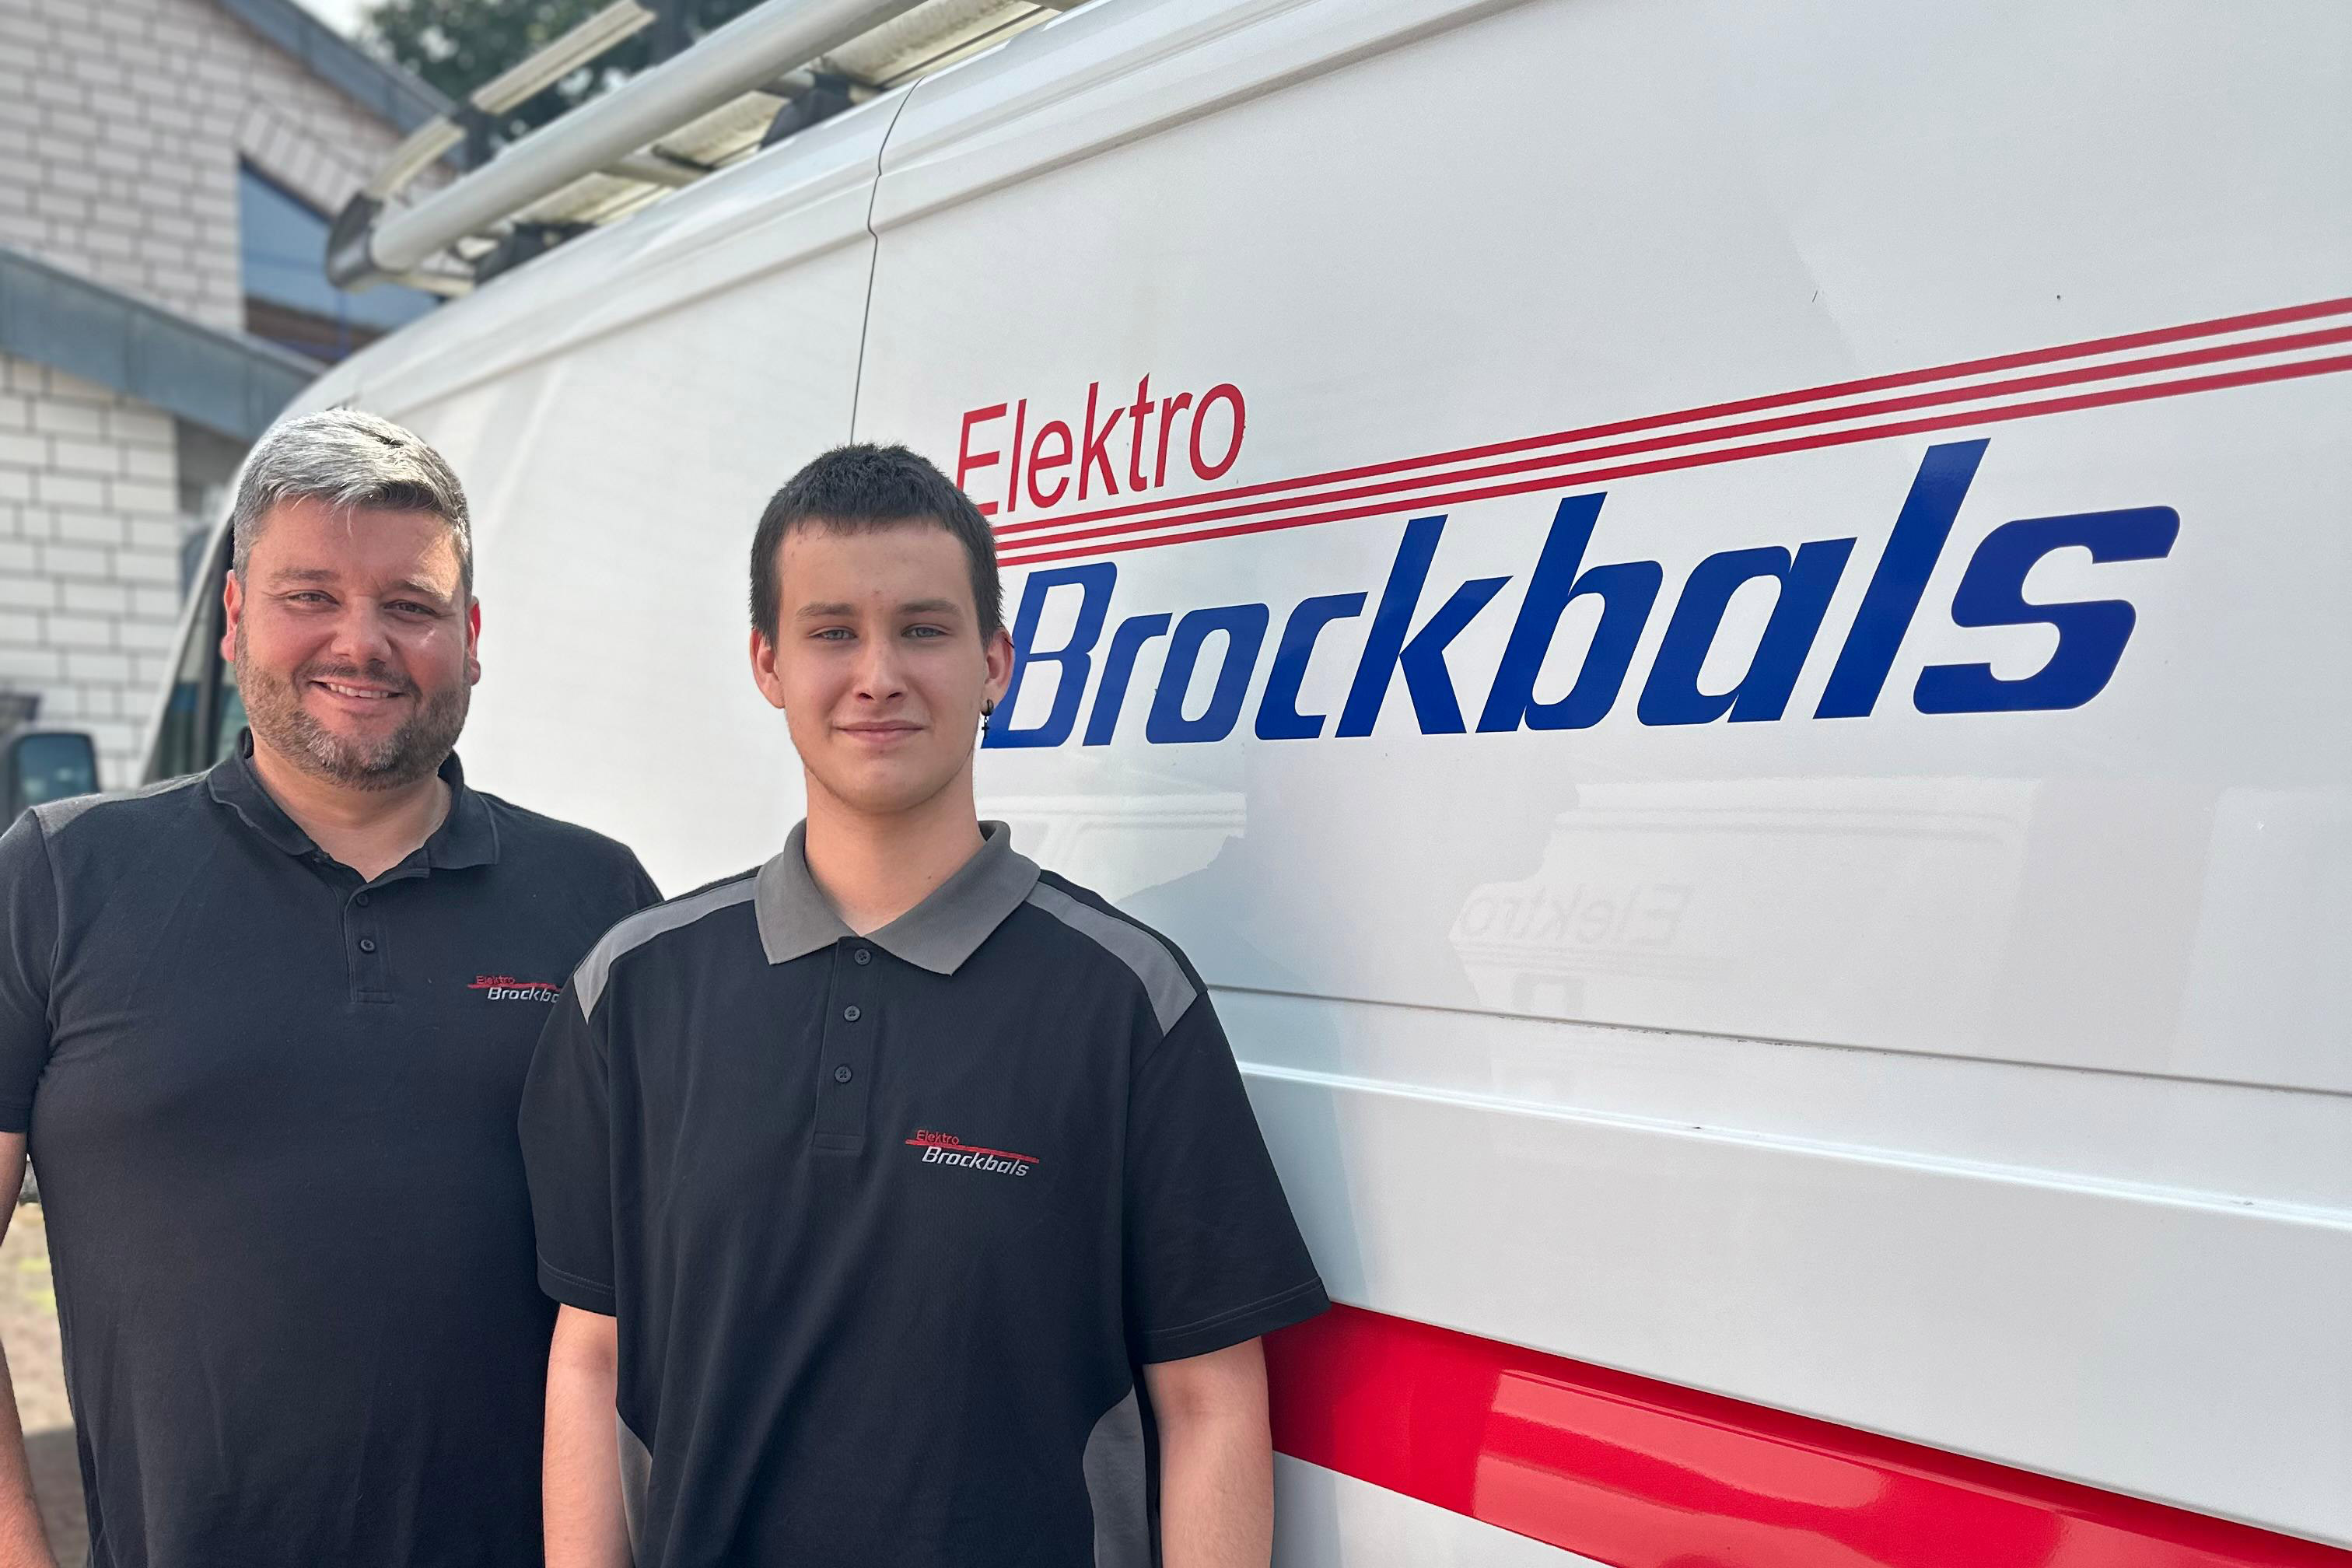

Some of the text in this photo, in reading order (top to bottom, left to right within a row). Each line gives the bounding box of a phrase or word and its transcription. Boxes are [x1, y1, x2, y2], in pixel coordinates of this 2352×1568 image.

[956, 373, 1247, 516] Elektro
[980, 437, 2181, 750] Brockbals
[475, 975, 516, 985] Elektro
[915, 1129, 960, 1145] Elektro
[922, 1146, 1030, 1177] Brockbals
